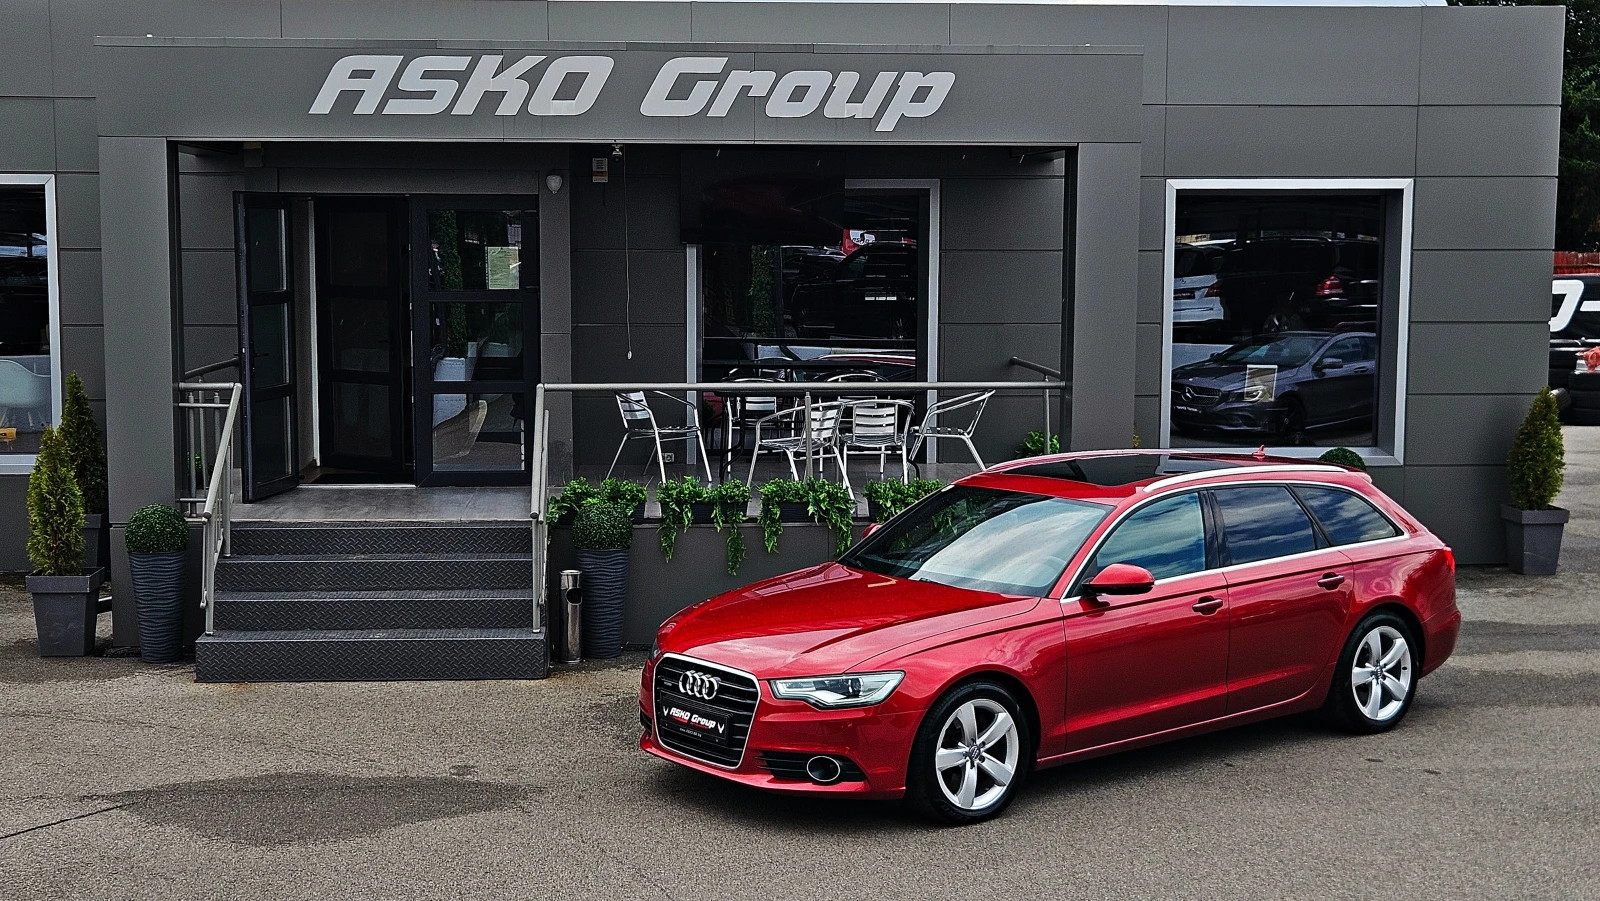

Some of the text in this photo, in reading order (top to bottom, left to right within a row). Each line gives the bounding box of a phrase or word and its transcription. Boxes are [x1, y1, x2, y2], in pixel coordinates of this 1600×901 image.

[308, 54, 956, 132] ASKO Group
[669, 707, 691, 720] ASKO
[691, 714, 716, 729] Group
